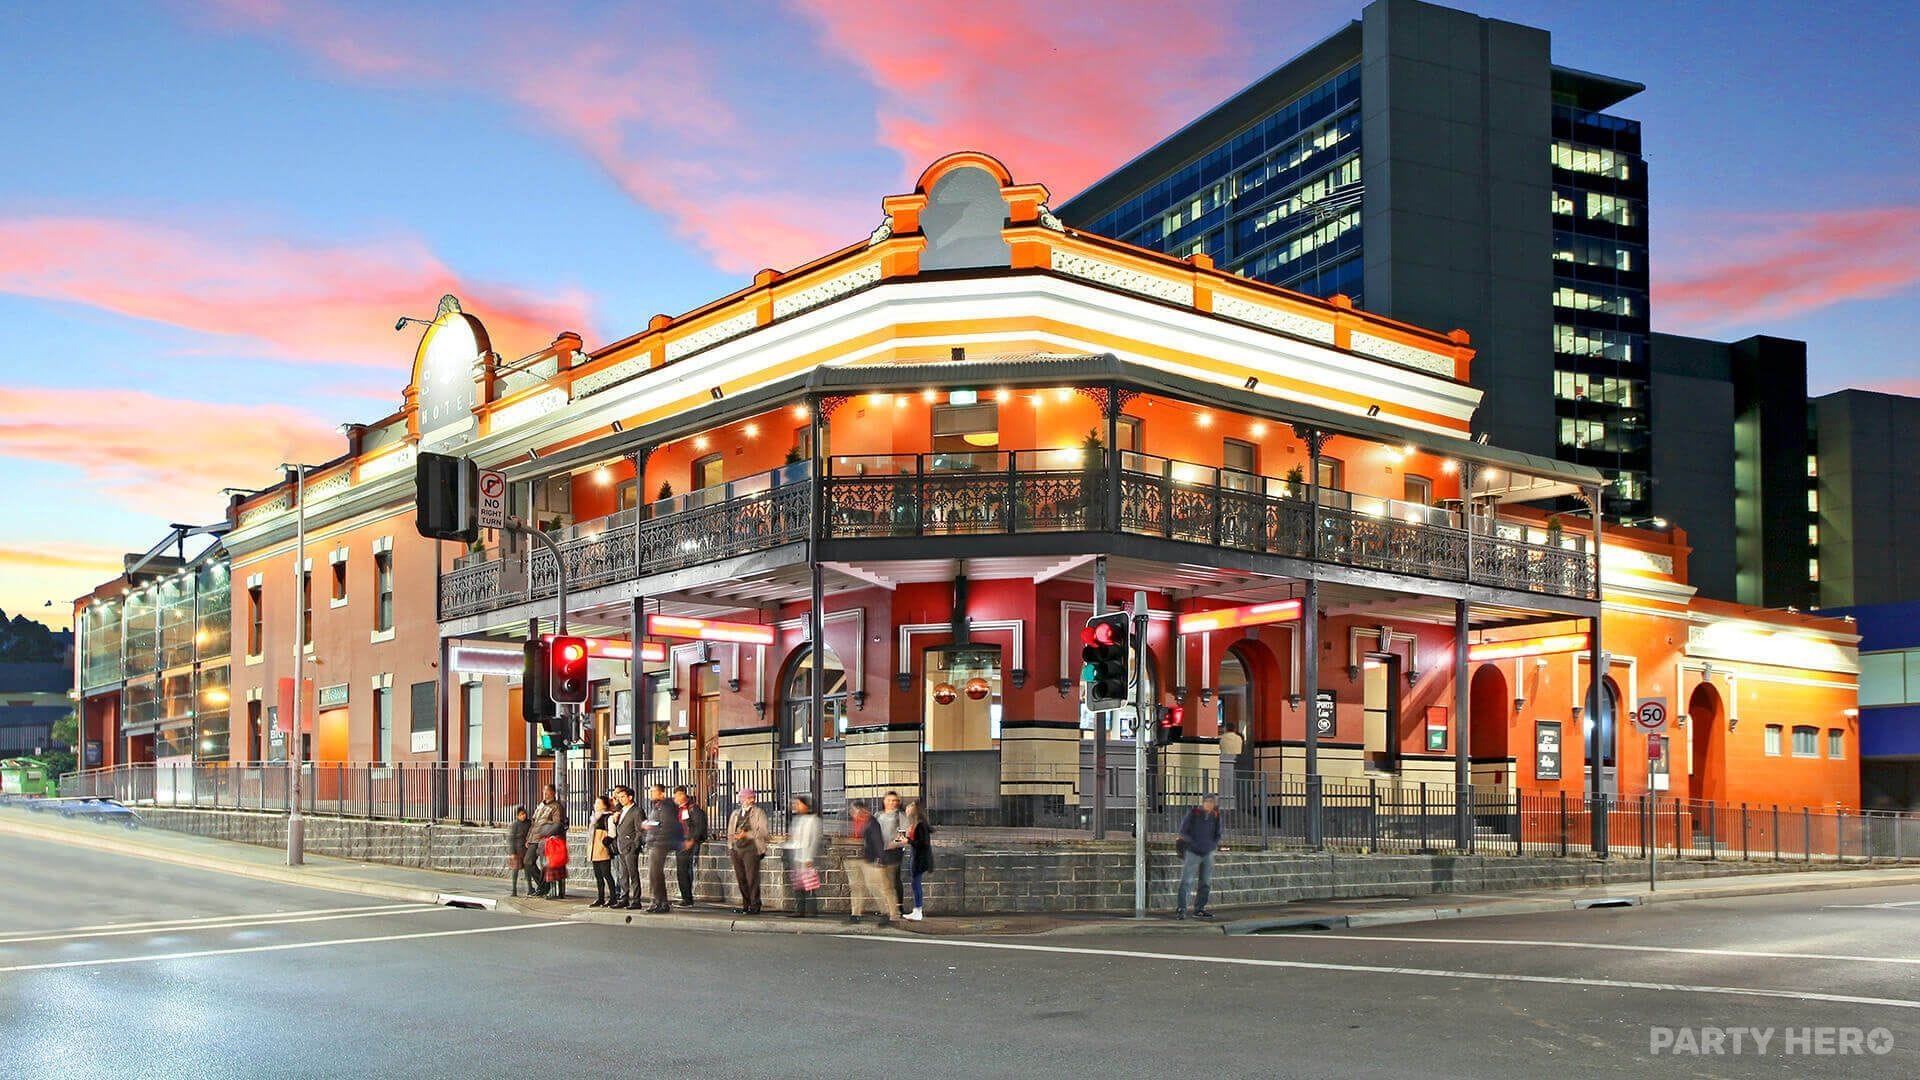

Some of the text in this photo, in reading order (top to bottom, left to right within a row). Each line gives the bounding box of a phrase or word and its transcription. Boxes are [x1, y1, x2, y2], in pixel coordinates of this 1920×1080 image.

[422, 391, 474, 425] HOTEL
[484, 499, 500, 509] NO
[480, 508, 502, 518] RIGHT
[482, 517, 502, 526] TURN
[1642, 708, 1663, 722] 50
